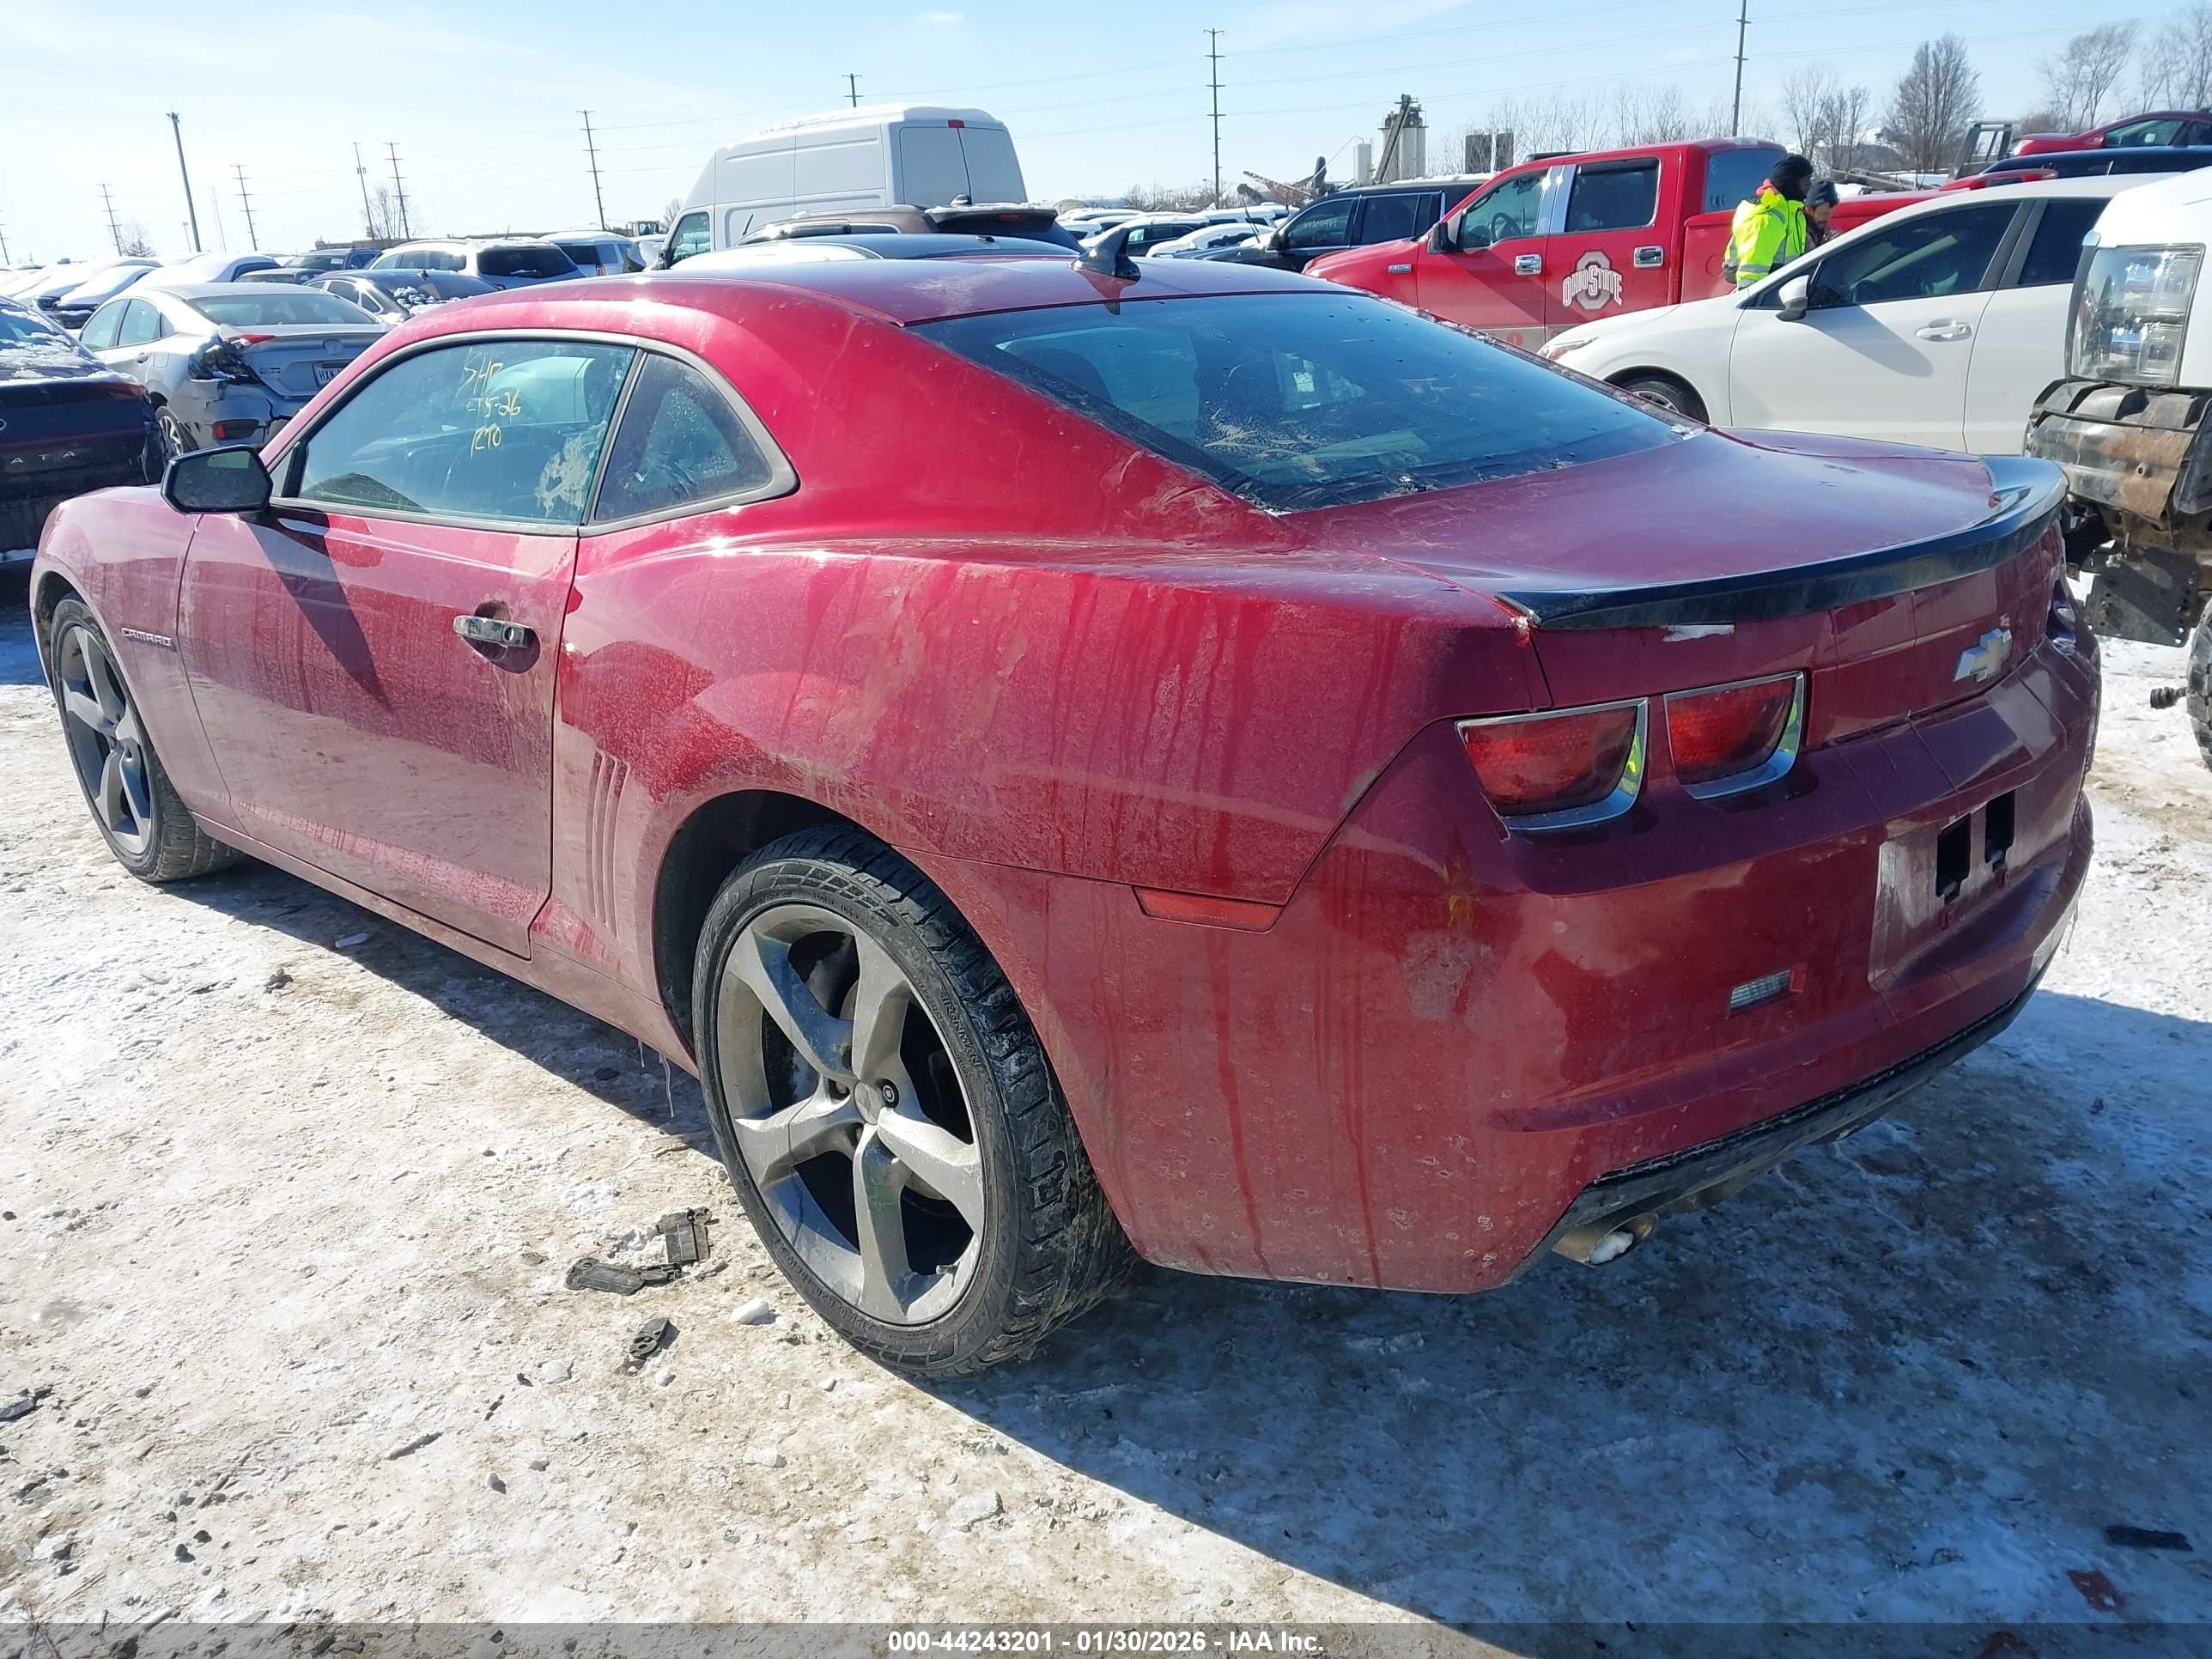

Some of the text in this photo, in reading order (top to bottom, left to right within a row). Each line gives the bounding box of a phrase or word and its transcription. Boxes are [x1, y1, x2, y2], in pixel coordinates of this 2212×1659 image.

[1562, 264, 1623, 307] OHIO STATE
[121, 627, 173, 647] CAMARO
